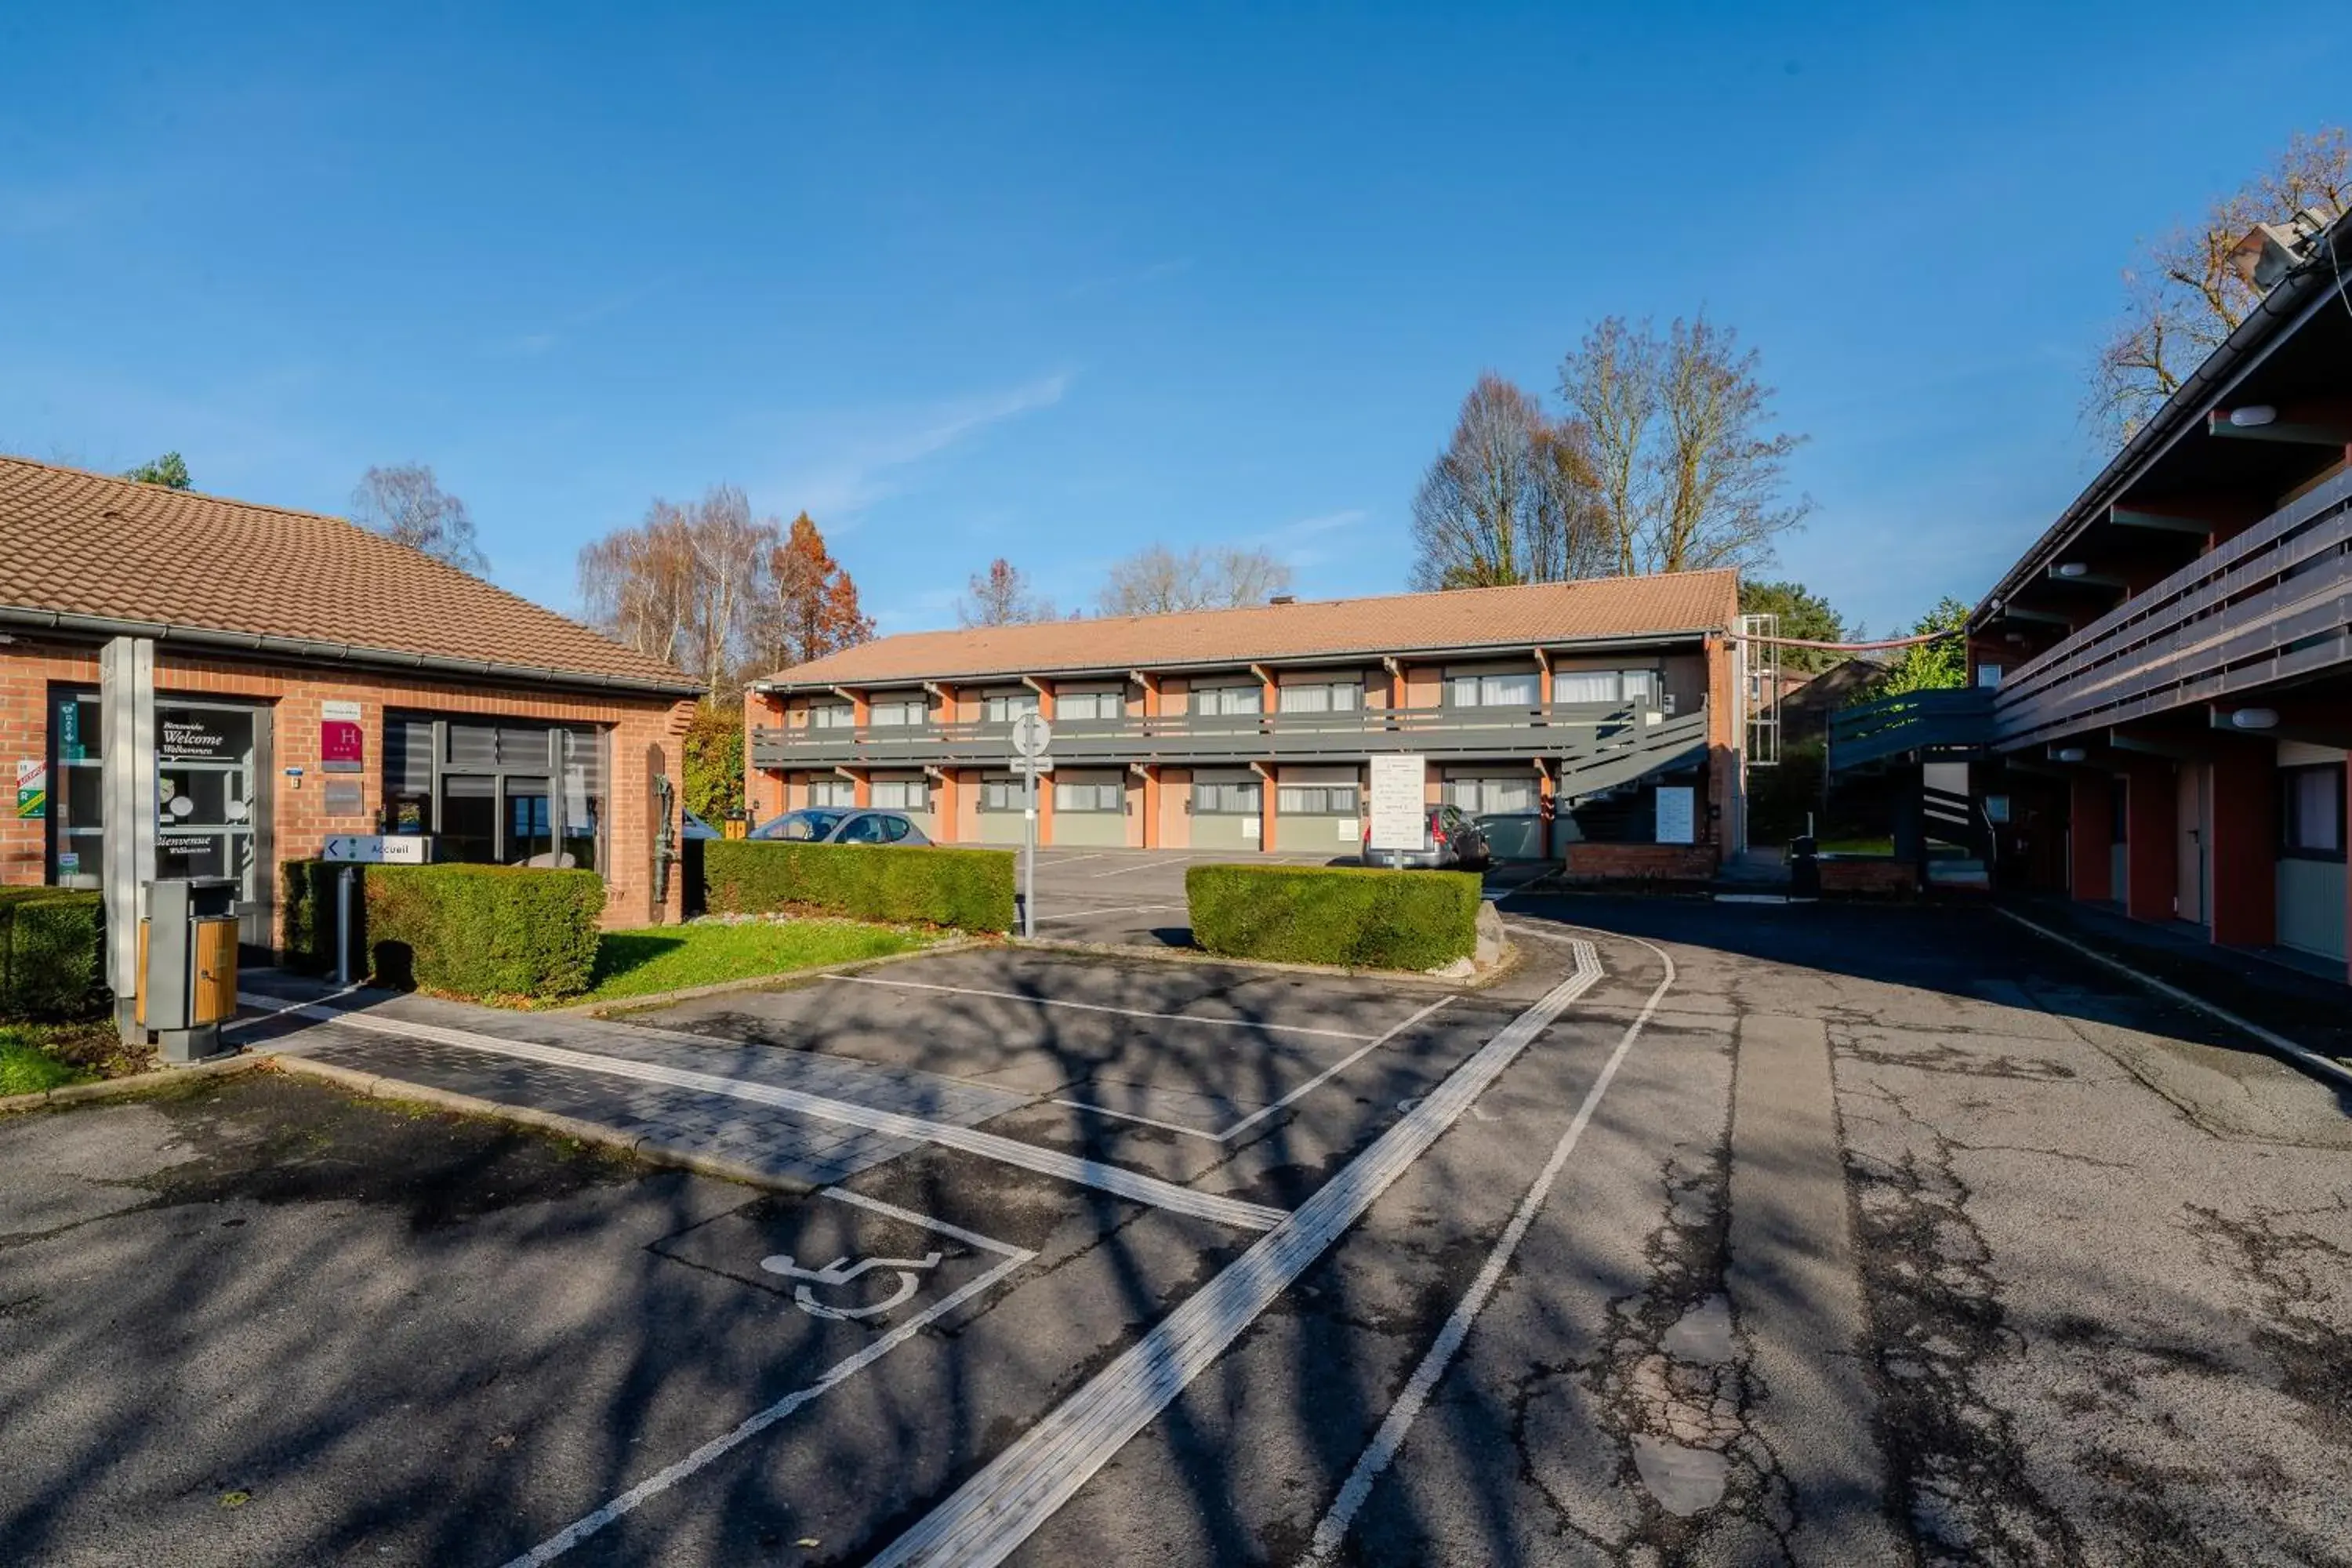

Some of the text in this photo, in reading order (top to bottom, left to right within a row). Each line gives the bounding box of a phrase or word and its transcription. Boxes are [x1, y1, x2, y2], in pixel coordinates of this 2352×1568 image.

[163, 731, 223, 746] Welcome
[341, 728, 357, 744] H
[371, 845, 409, 855] Accueil
